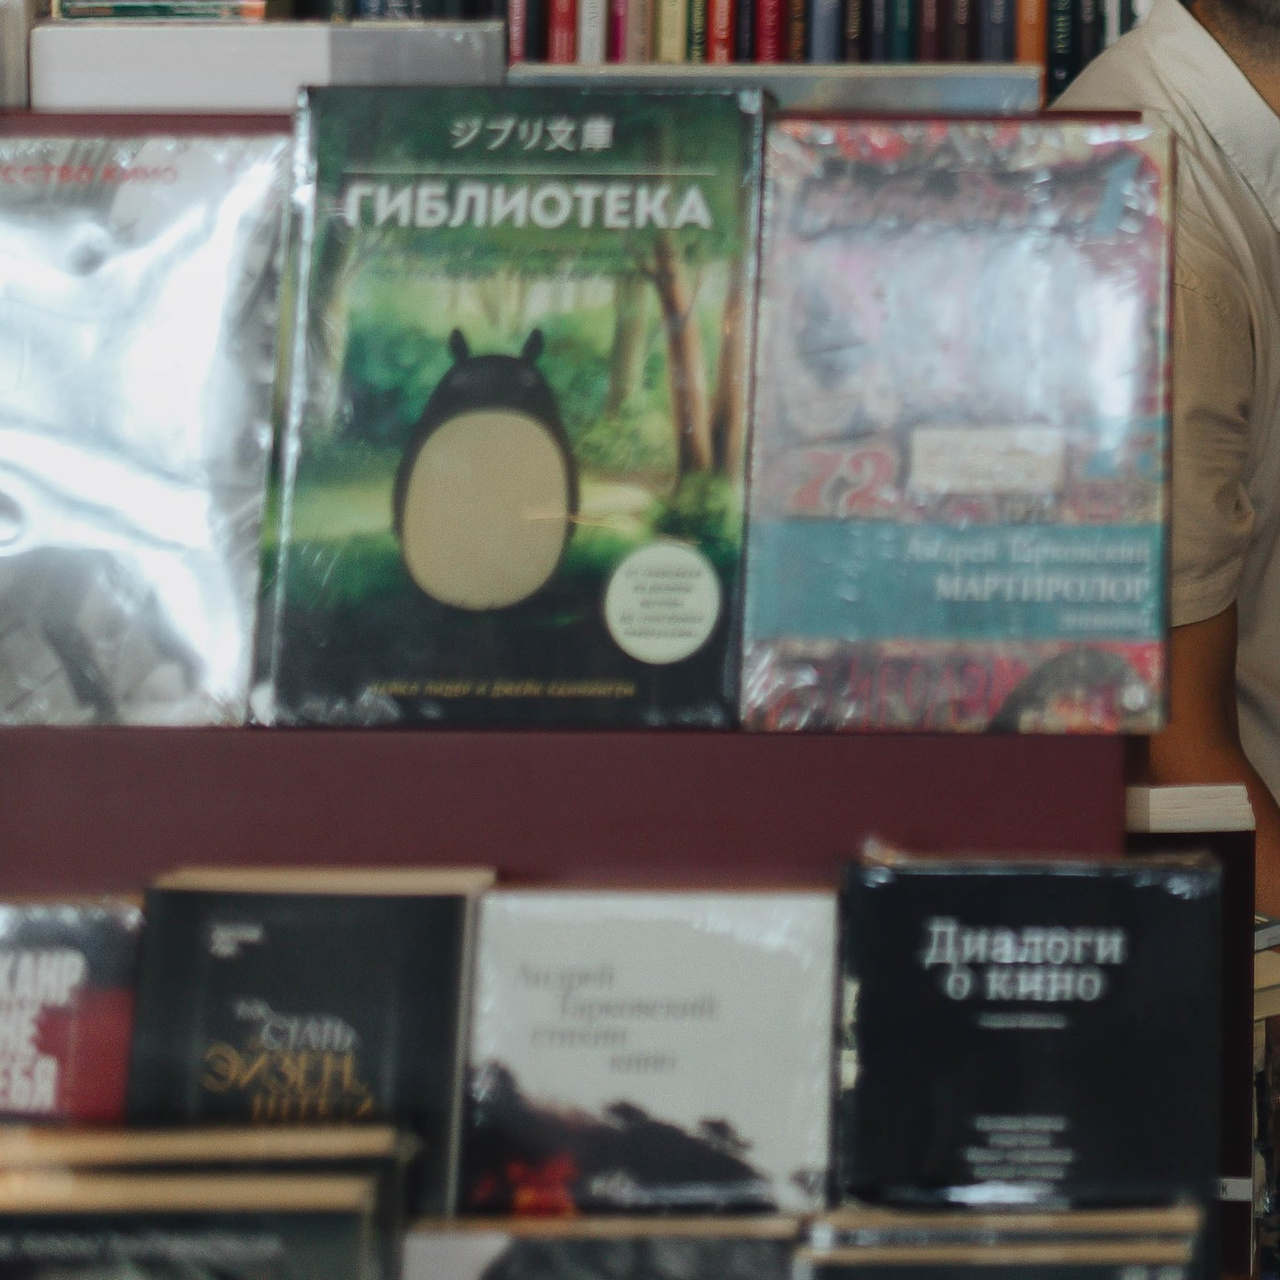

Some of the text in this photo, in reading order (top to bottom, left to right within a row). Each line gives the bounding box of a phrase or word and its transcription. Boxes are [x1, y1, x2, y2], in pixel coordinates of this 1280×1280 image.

[0, 163, 95, 186] ССТВО
[343, 181, 712, 230] ГИБЛИОТЕКА
[935, 574, 1150, 603] МАРТИРОЛОГ
[923, 916, 1126, 970] Диалоги
[944, 968, 1105, 1002] о кино
